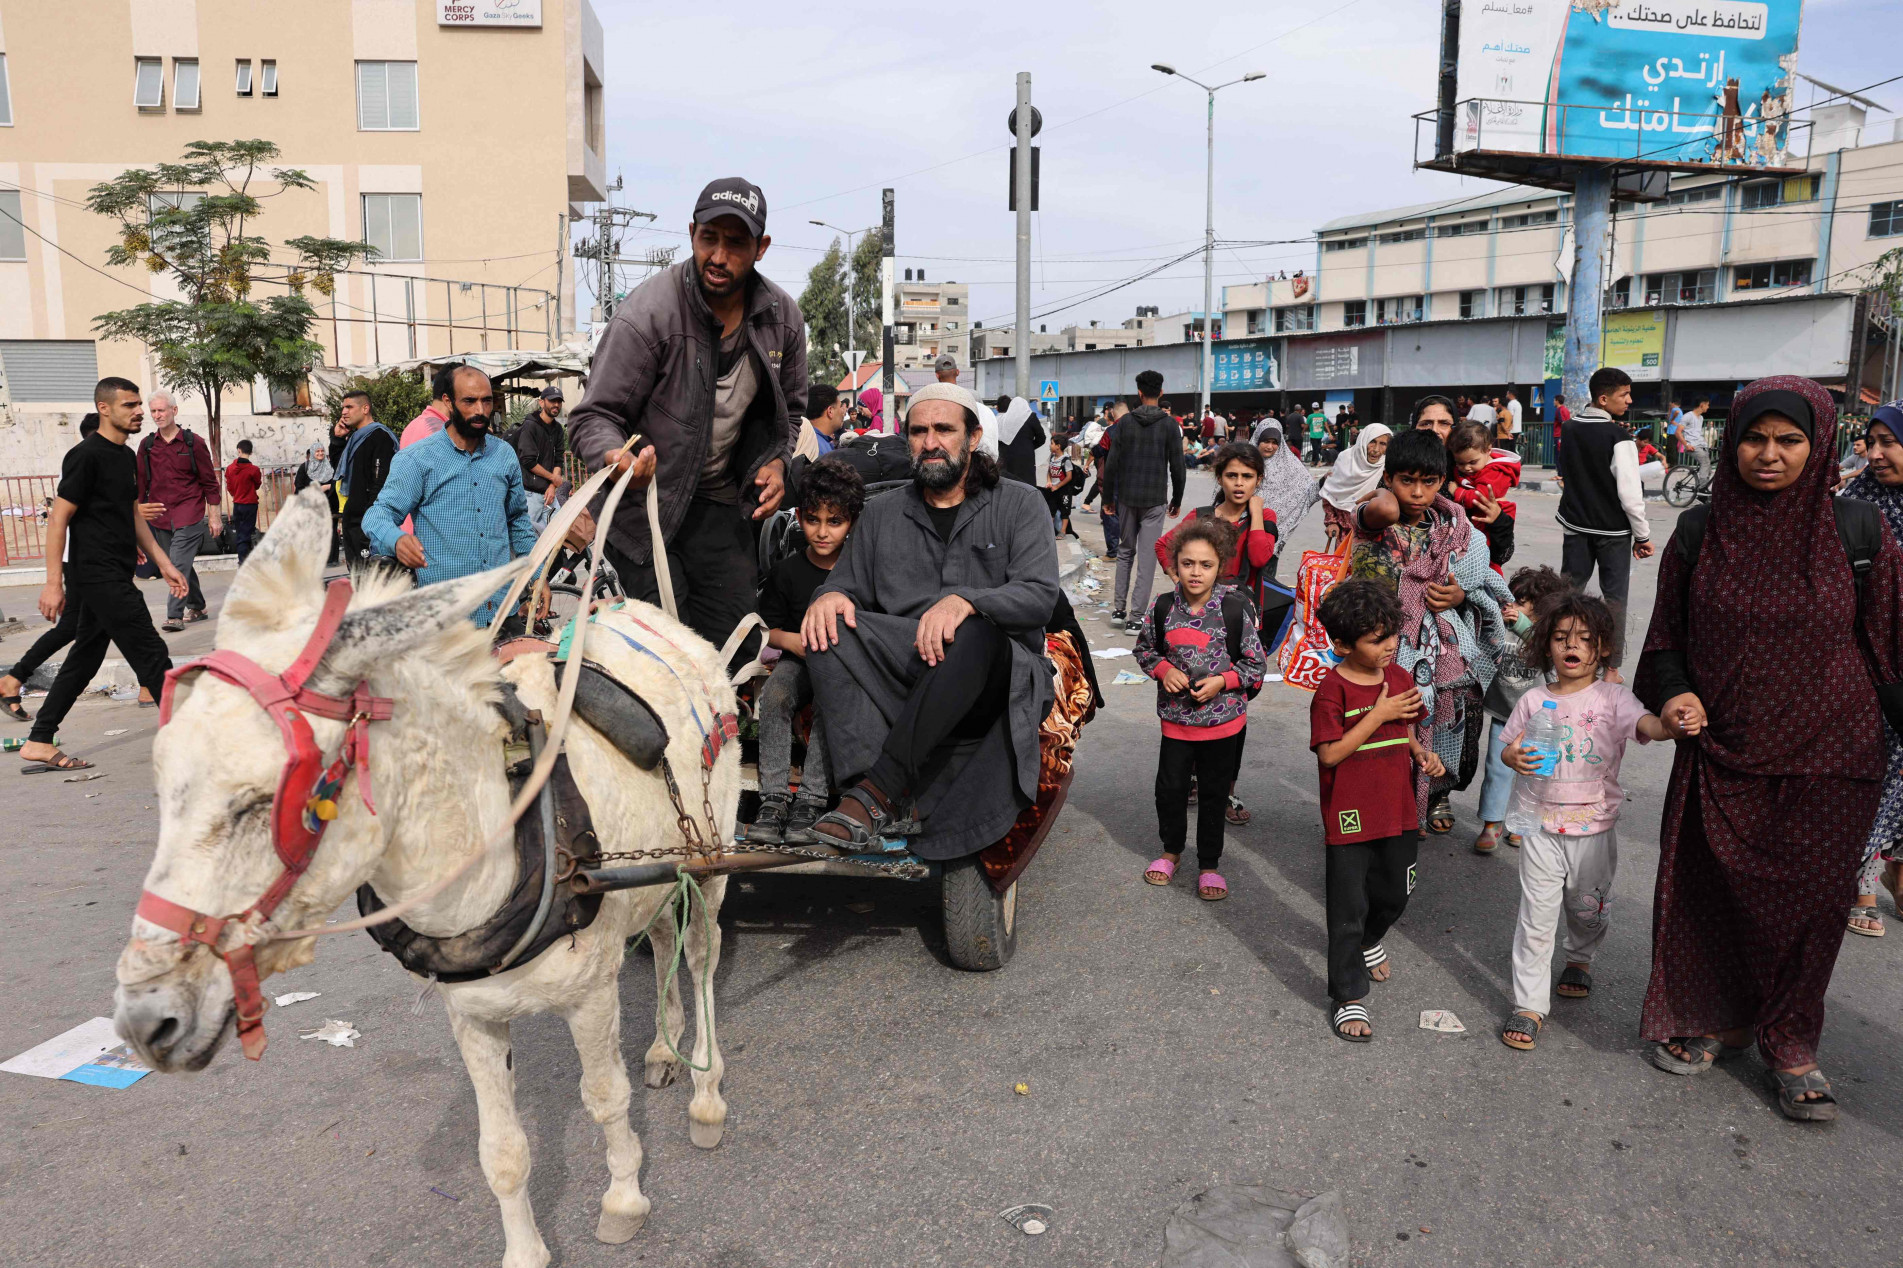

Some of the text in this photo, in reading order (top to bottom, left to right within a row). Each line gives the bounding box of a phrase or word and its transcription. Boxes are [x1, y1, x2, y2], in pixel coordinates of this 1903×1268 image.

[444, 5, 475, 14] MERCY
[444, 13, 475, 22] CORPS
[501, 12, 512, 20] Sky
[513, 12, 534, 20] Geeks
[1627, 4, 1672, 25] صحتك
[1676, 9, 1708, 30] على
[1712, 11, 1762, 31] لتحافظ
[1482, 39, 1531, 54] صحتك أهم
[1642, 50, 1725, 92] ارتدي
[711, 190, 756, 212] adidas
[1291, 655, 1331, 682] Pe
[1360, 704, 1374, 713] FAS
